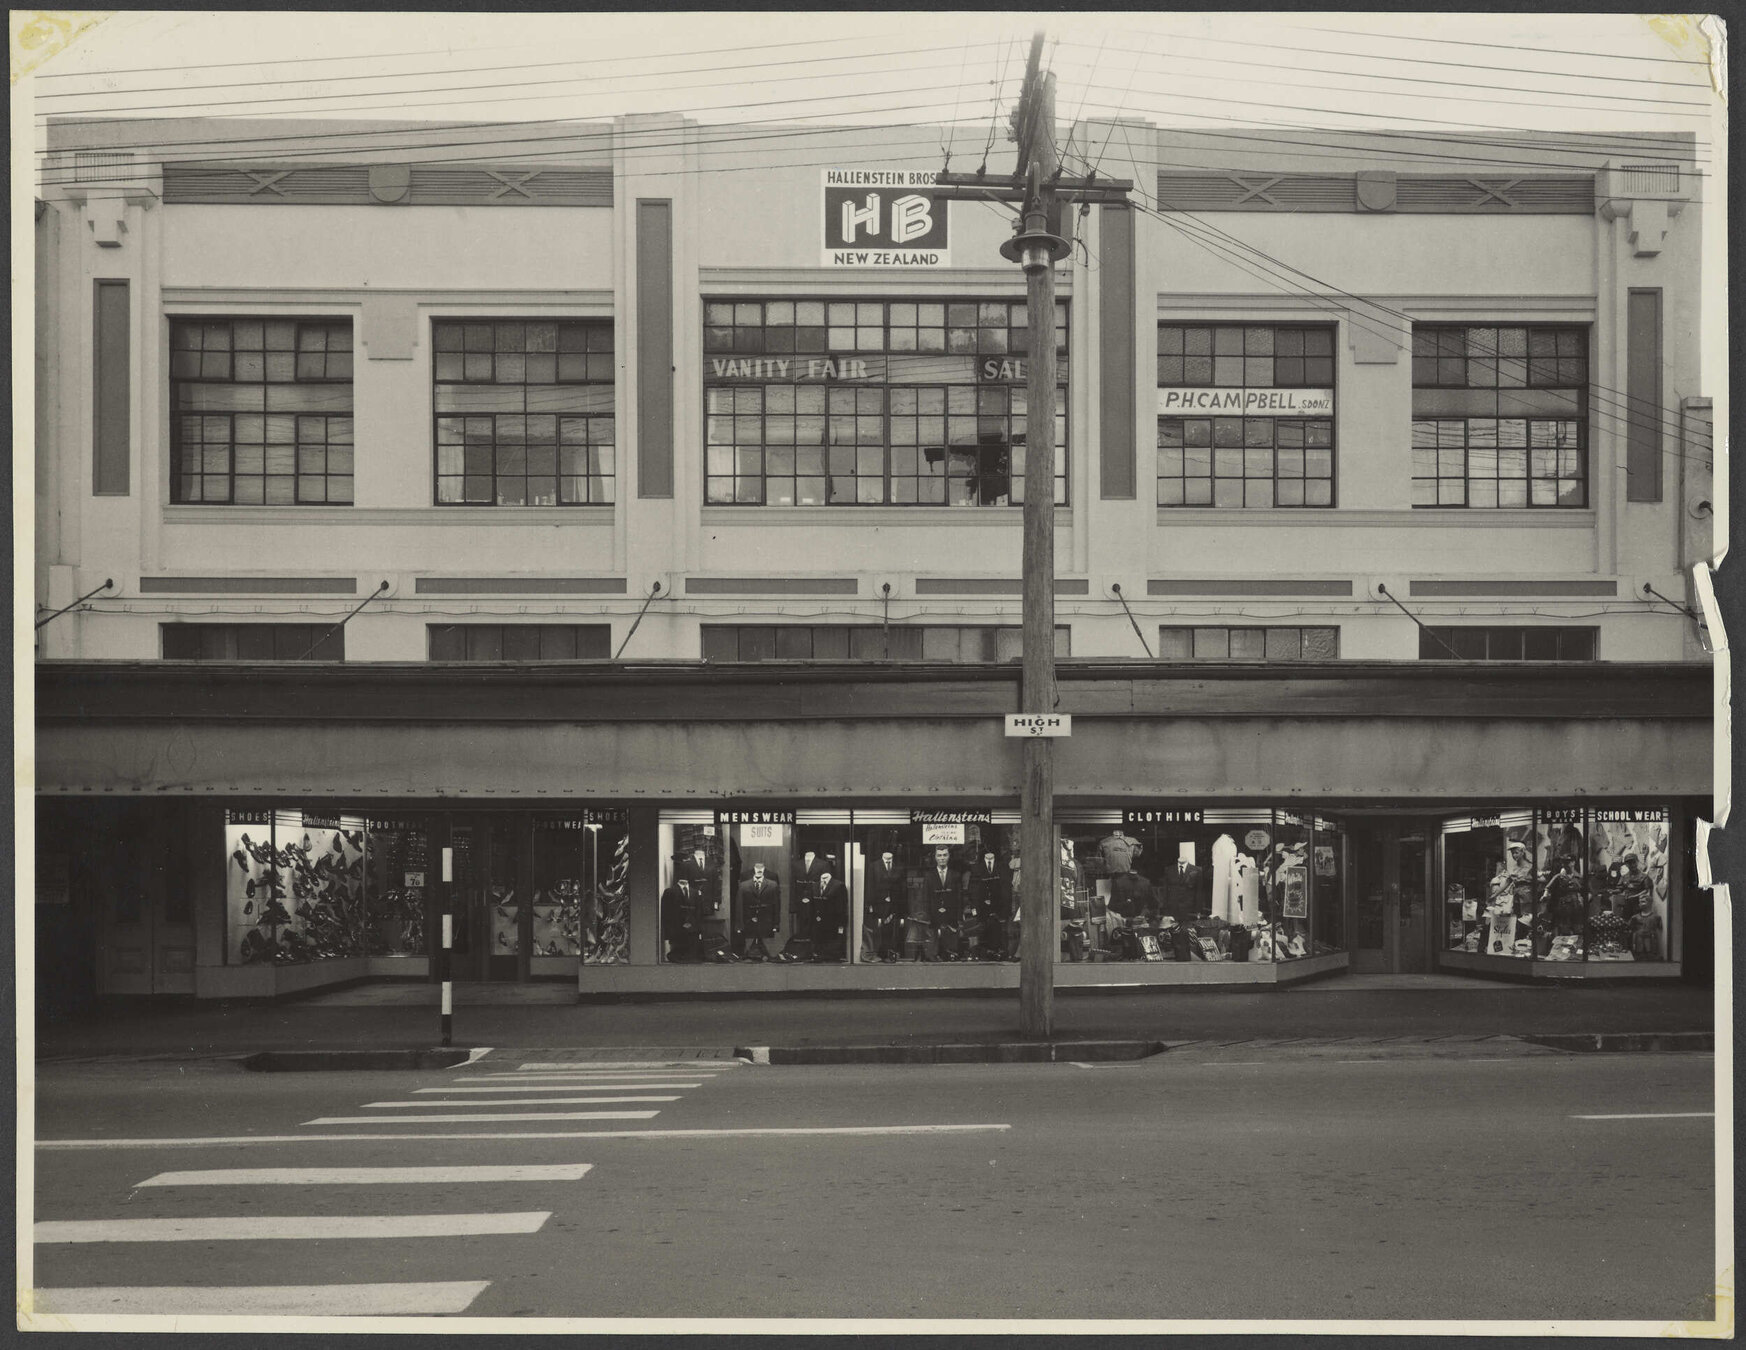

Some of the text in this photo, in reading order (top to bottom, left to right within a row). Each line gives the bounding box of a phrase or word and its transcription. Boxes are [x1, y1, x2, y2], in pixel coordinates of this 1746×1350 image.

[827, 171, 904, 185] HALLENSTEIN
[834, 252, 939, 265] NEW ZEALAND
[712, 359, 1027, 379] VANITY FAIR SAL
[1014, 718, 1060, 727] HIGH
[230, 811, 269, 824] SHOES
[589, 811, 626, 822] SHOES
[720, 812, 793, 822] MENSWEAR
[912, 810, 991, 824] Hallensteins
[1128, 812, 1201, 822] CLOTHING
[1546, 809, 1576, 819] BOYS
[1597, 810, 1662, 821] SCHOOL WEAR
[751, 826, 773, 838] SUITS
